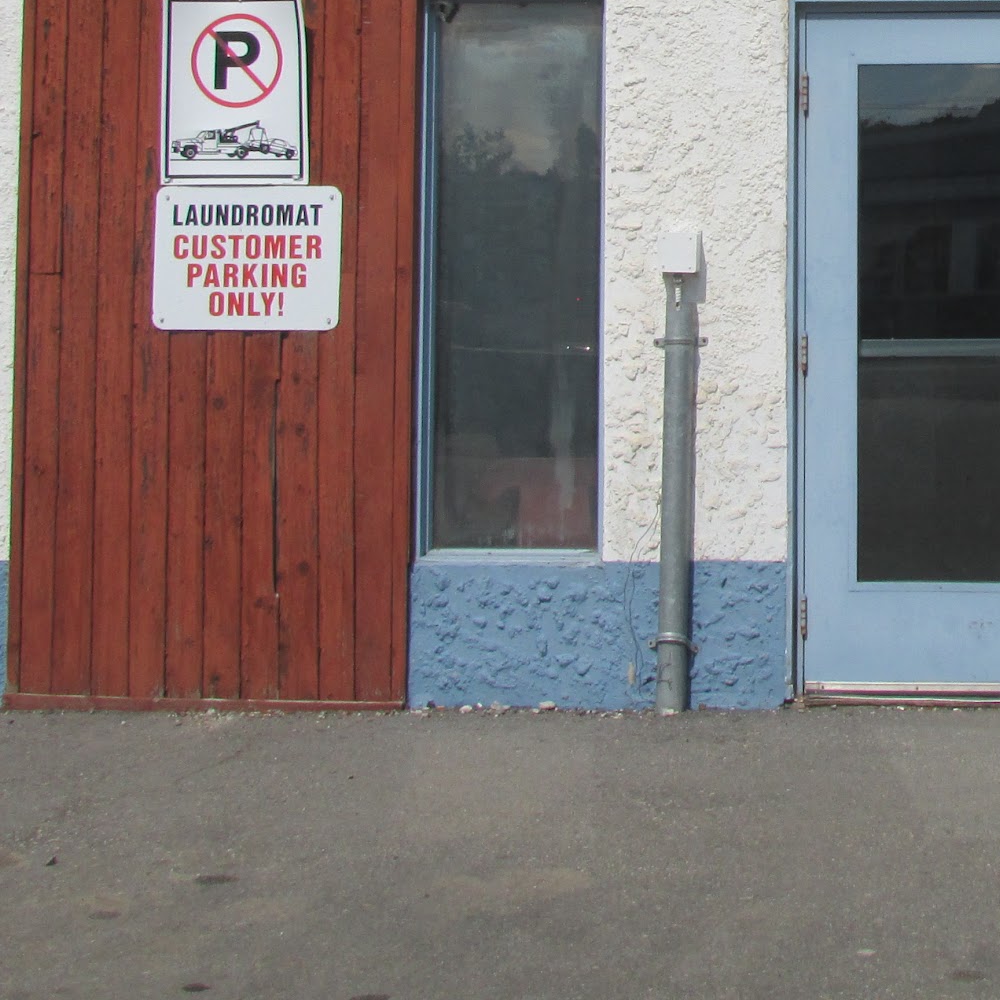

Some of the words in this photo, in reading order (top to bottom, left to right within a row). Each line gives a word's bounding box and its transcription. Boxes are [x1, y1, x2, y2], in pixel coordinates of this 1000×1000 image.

[213, 30, 261, 90] P
[172, 204, 323, 227] LAUNDROMAT
[173, 234, 322, 260] CUSTOMER
[186, 264, 308, 289] PARKING
[208, 291, 284, 318] ONLY!
